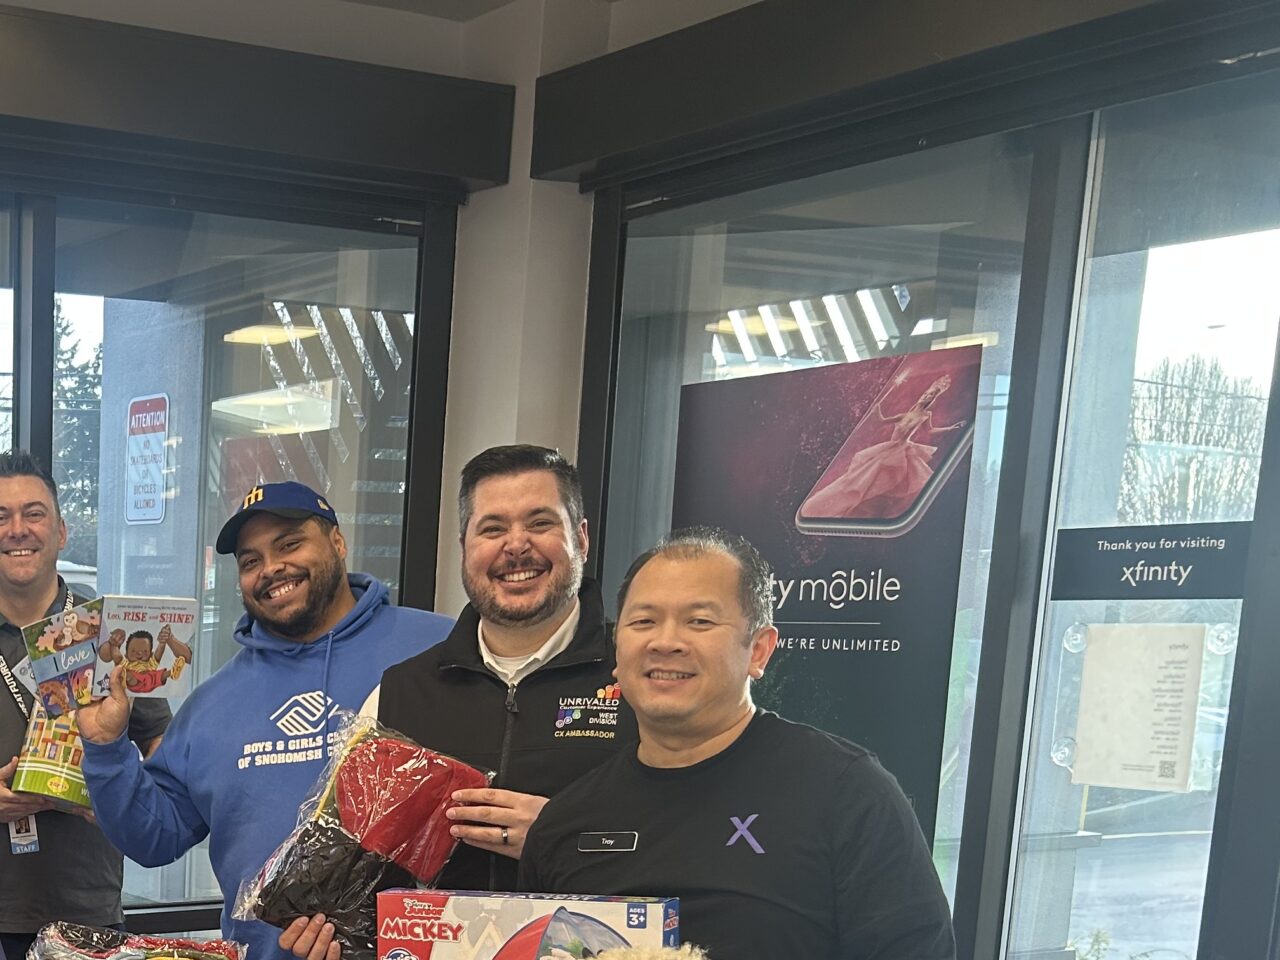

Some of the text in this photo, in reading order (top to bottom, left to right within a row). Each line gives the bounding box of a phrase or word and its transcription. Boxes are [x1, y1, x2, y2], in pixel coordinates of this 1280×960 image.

[130, 410, 165, 429] ATTENTION
[133, 484, 156, 495] BICYCLES
[134, 499, 155, 510] ALLOWED
[1098, 536, 1226, 552] Thank you for visiting
[1121, 560, 1193, 586] xfinity
[123, 611, 148, 622] RISE
[159, 612, 194, 624] SHINE!
[776, 638, 901, 652] WE'RE UNLIMITED
[61, 650, 90, 670] love
[559, 697, 620, 706] UNRIVALED
[589, 717, 617, 726] DIVISION
[554, 729, 615, 739] CX AMBASSADOR
[243, 735, 324, 755] BOYS & GIRLS
[237, 756, 252, 770] OF
[254, 748, 323, 766] SNOHOMISH
[16, 844, 36, 853] STAFF
[403, 898, 432, 909] Disney
[405, 905, 445, 918] Junior
[629, 914, 646, 926] 3+
[380, 917, 464, 943] MICKEY
